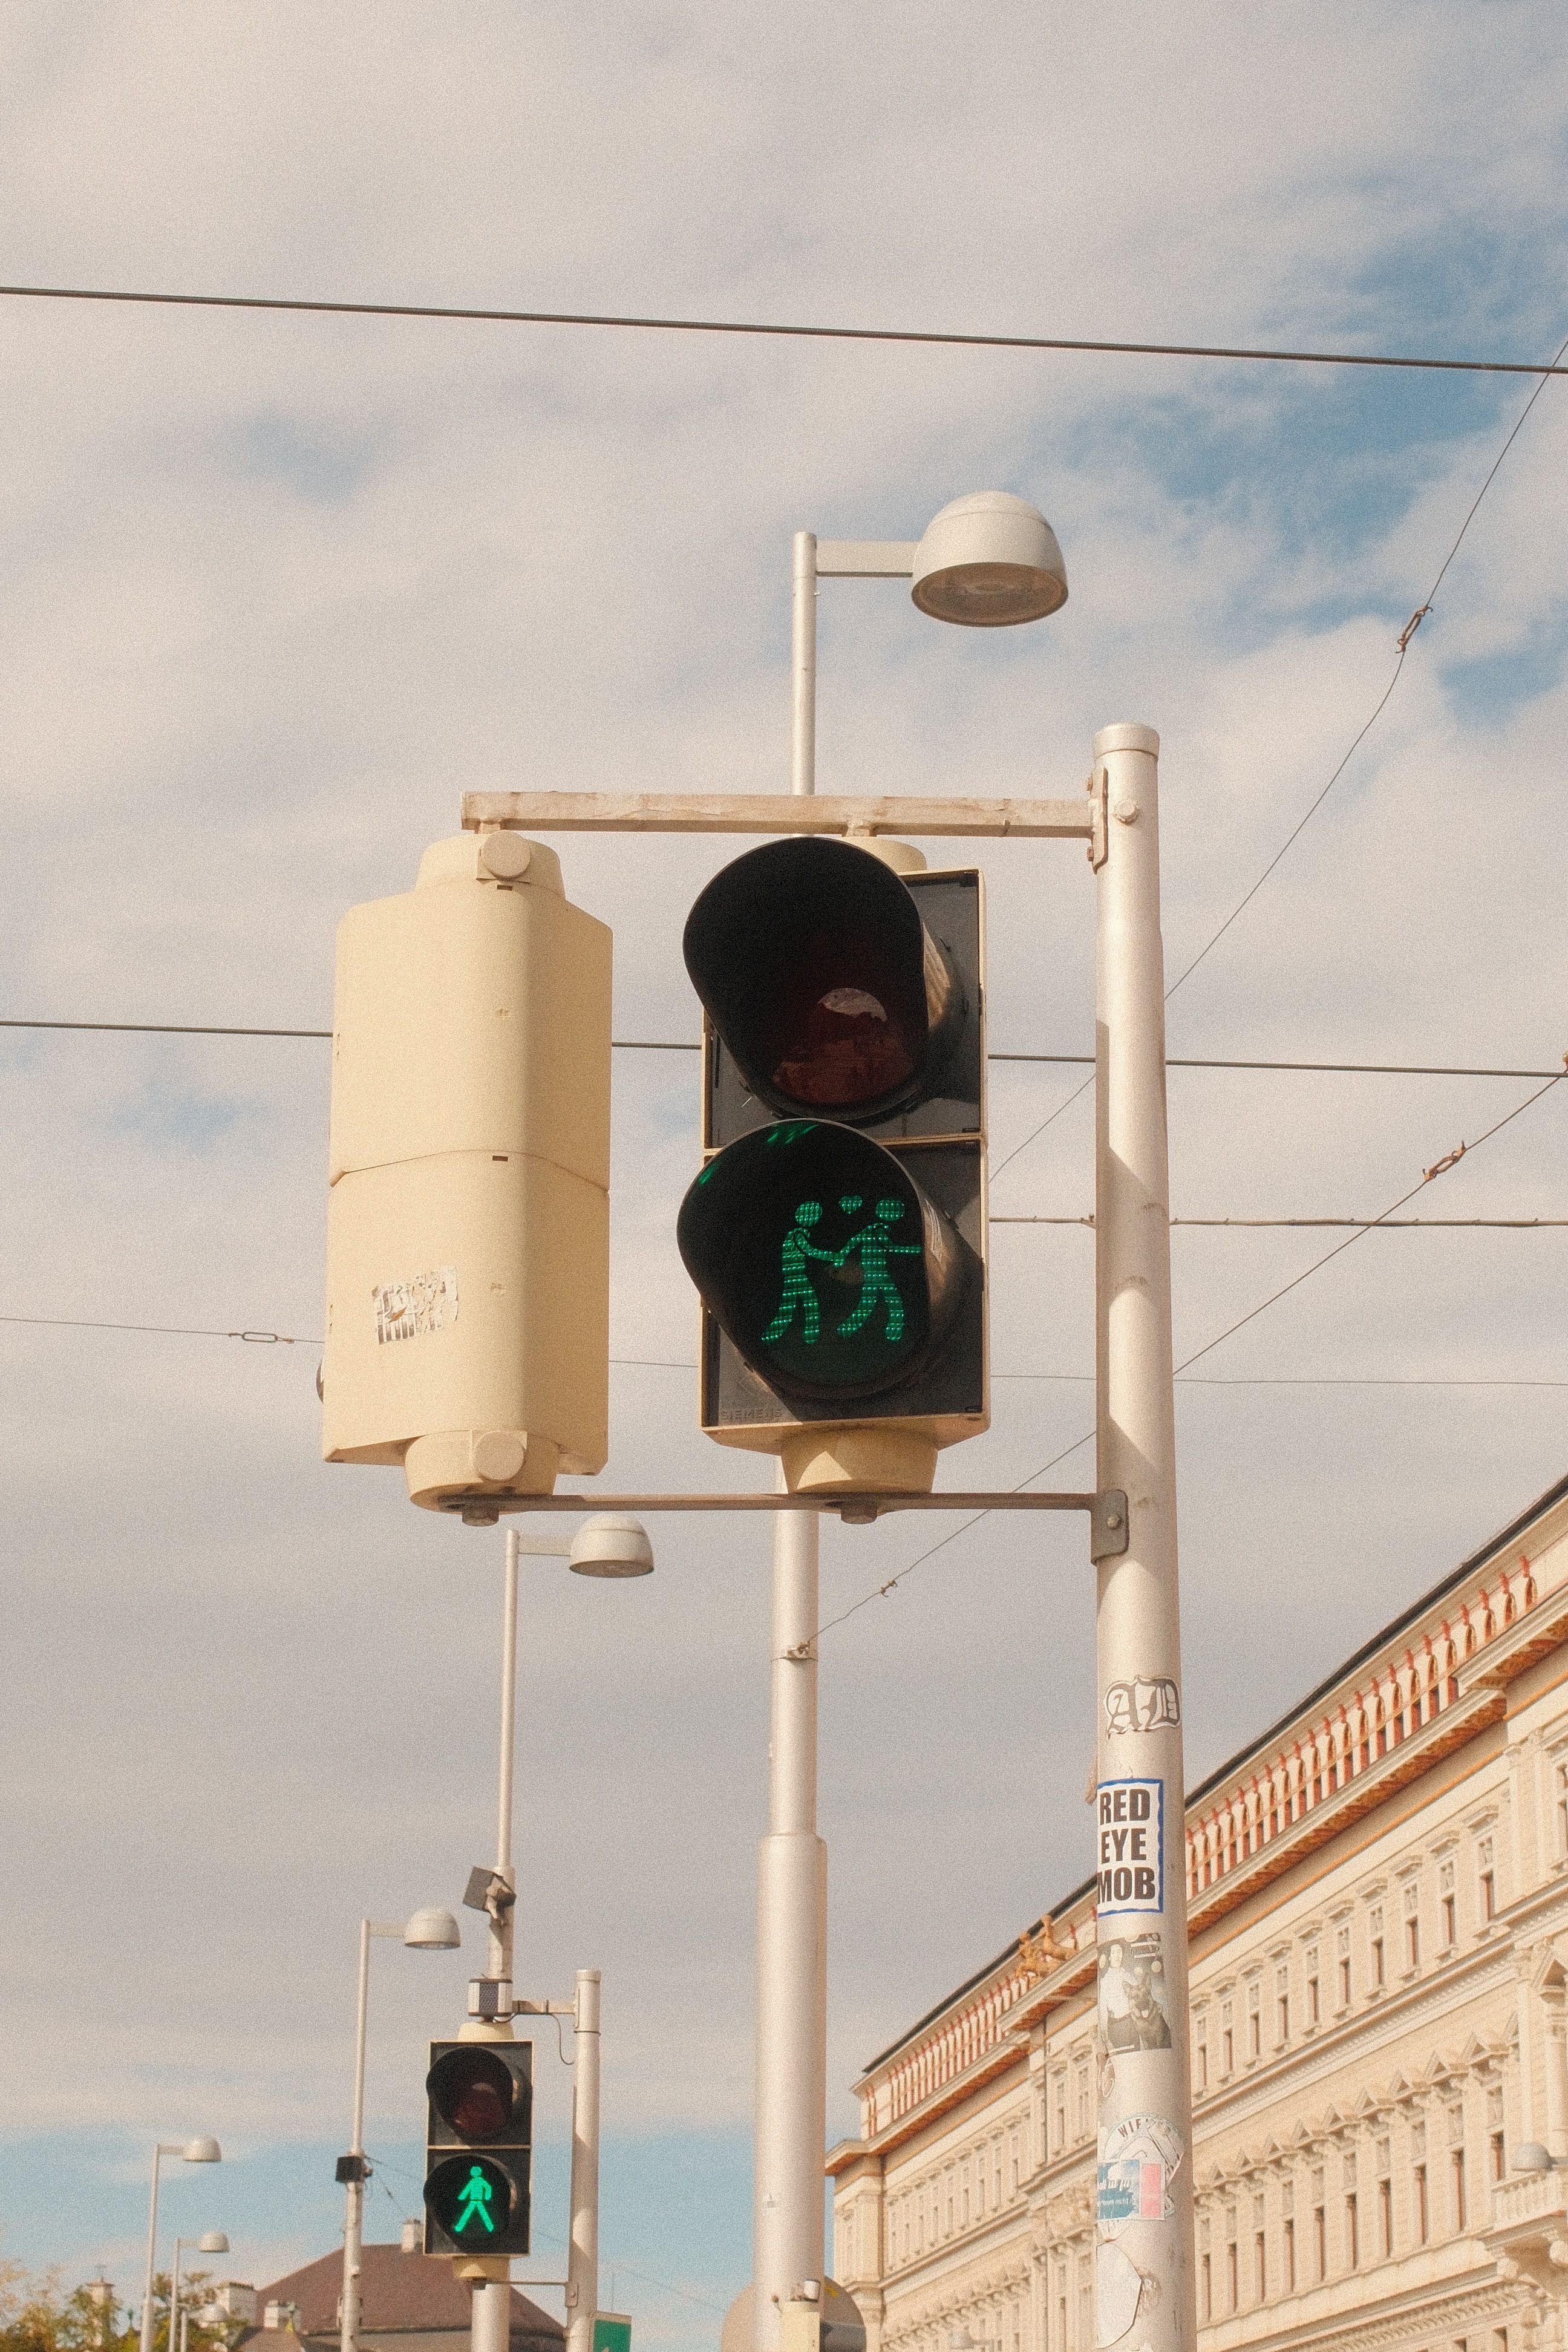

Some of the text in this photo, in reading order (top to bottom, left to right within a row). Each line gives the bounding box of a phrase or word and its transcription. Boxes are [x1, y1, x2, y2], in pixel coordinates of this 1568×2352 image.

[722, 1408, 783, 1420] SIEMENS
[1100, 1789, 1149, 1825] RED
[1101, 1828, 1147, 1864] EYE
[1097, 1867, 1155, 1904] MOB
